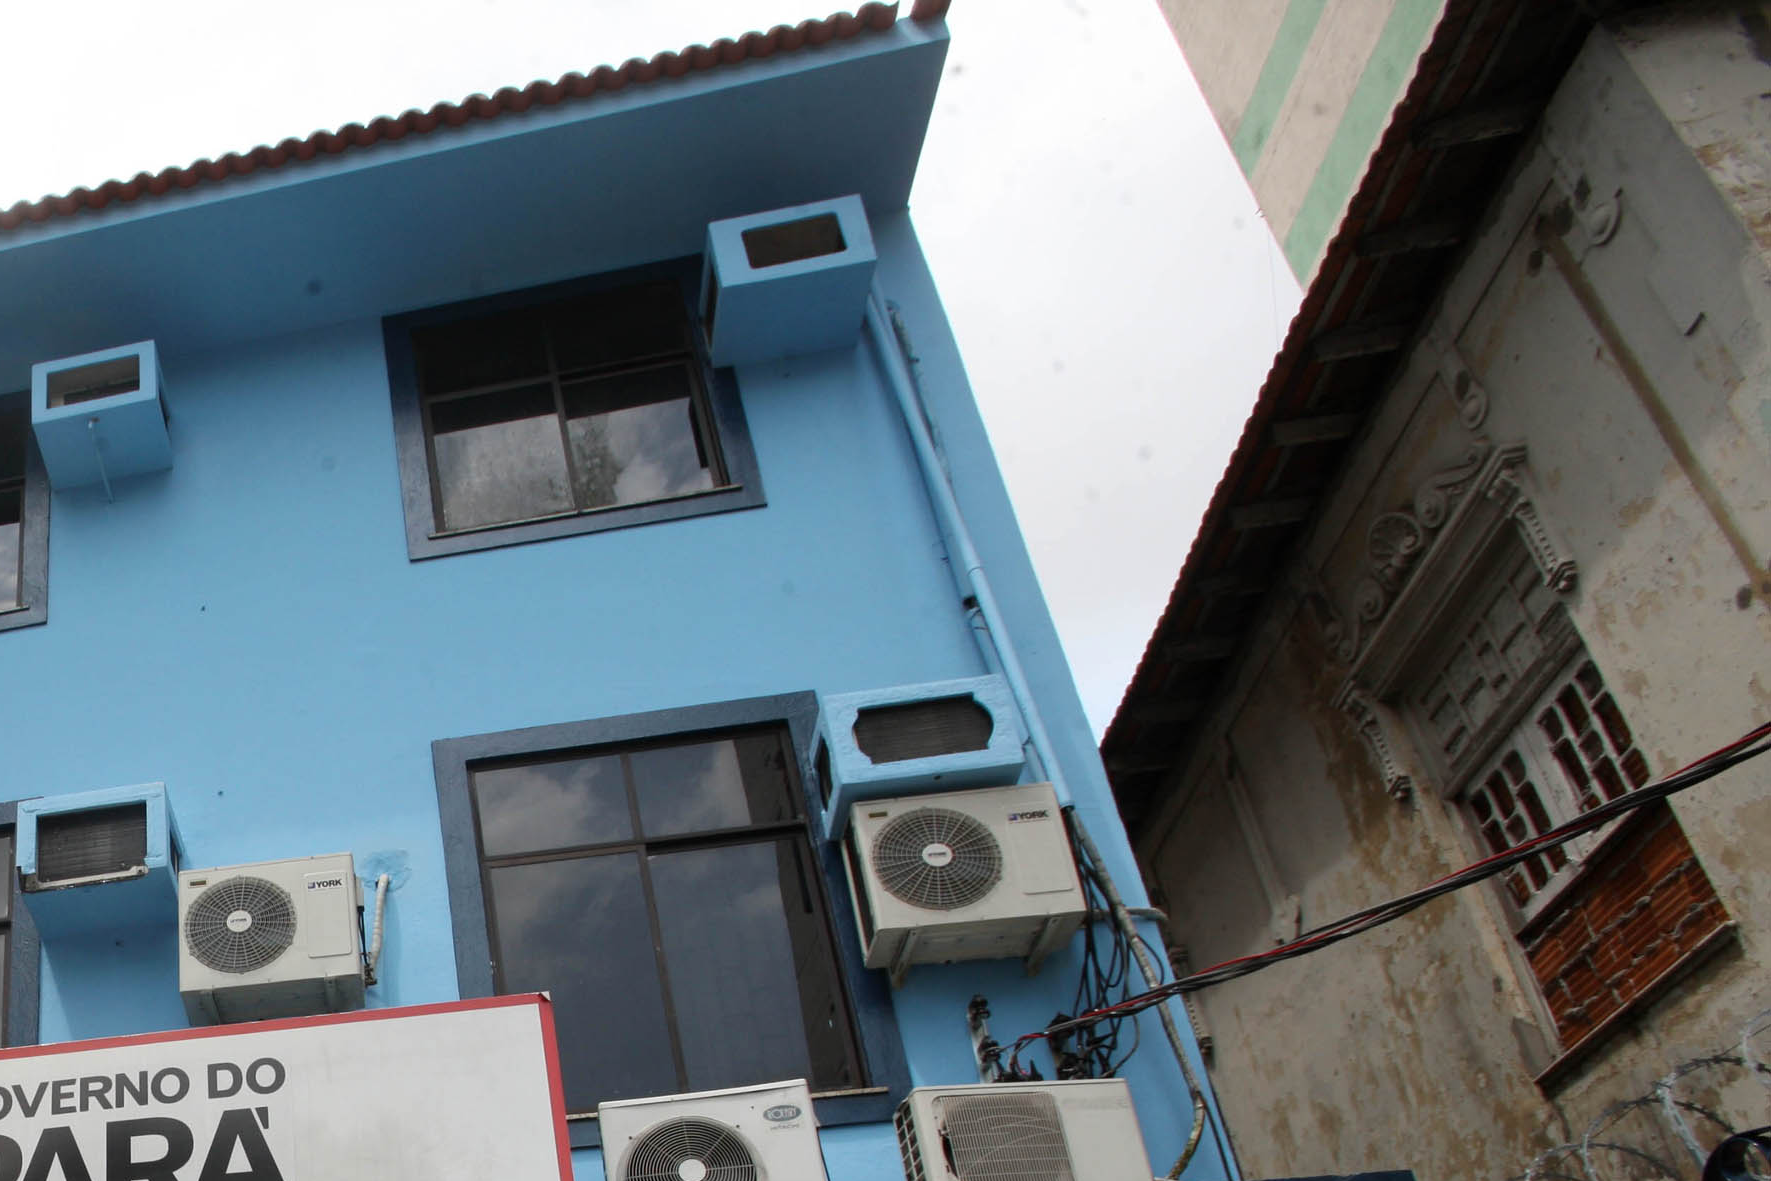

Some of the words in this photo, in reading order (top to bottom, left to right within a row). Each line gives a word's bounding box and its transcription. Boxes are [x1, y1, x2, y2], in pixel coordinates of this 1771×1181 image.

[1019, 809, 1049, 820] YORK
[316, 879, 342, 888] YORK
[206, 1057, 286, 1099] DO
